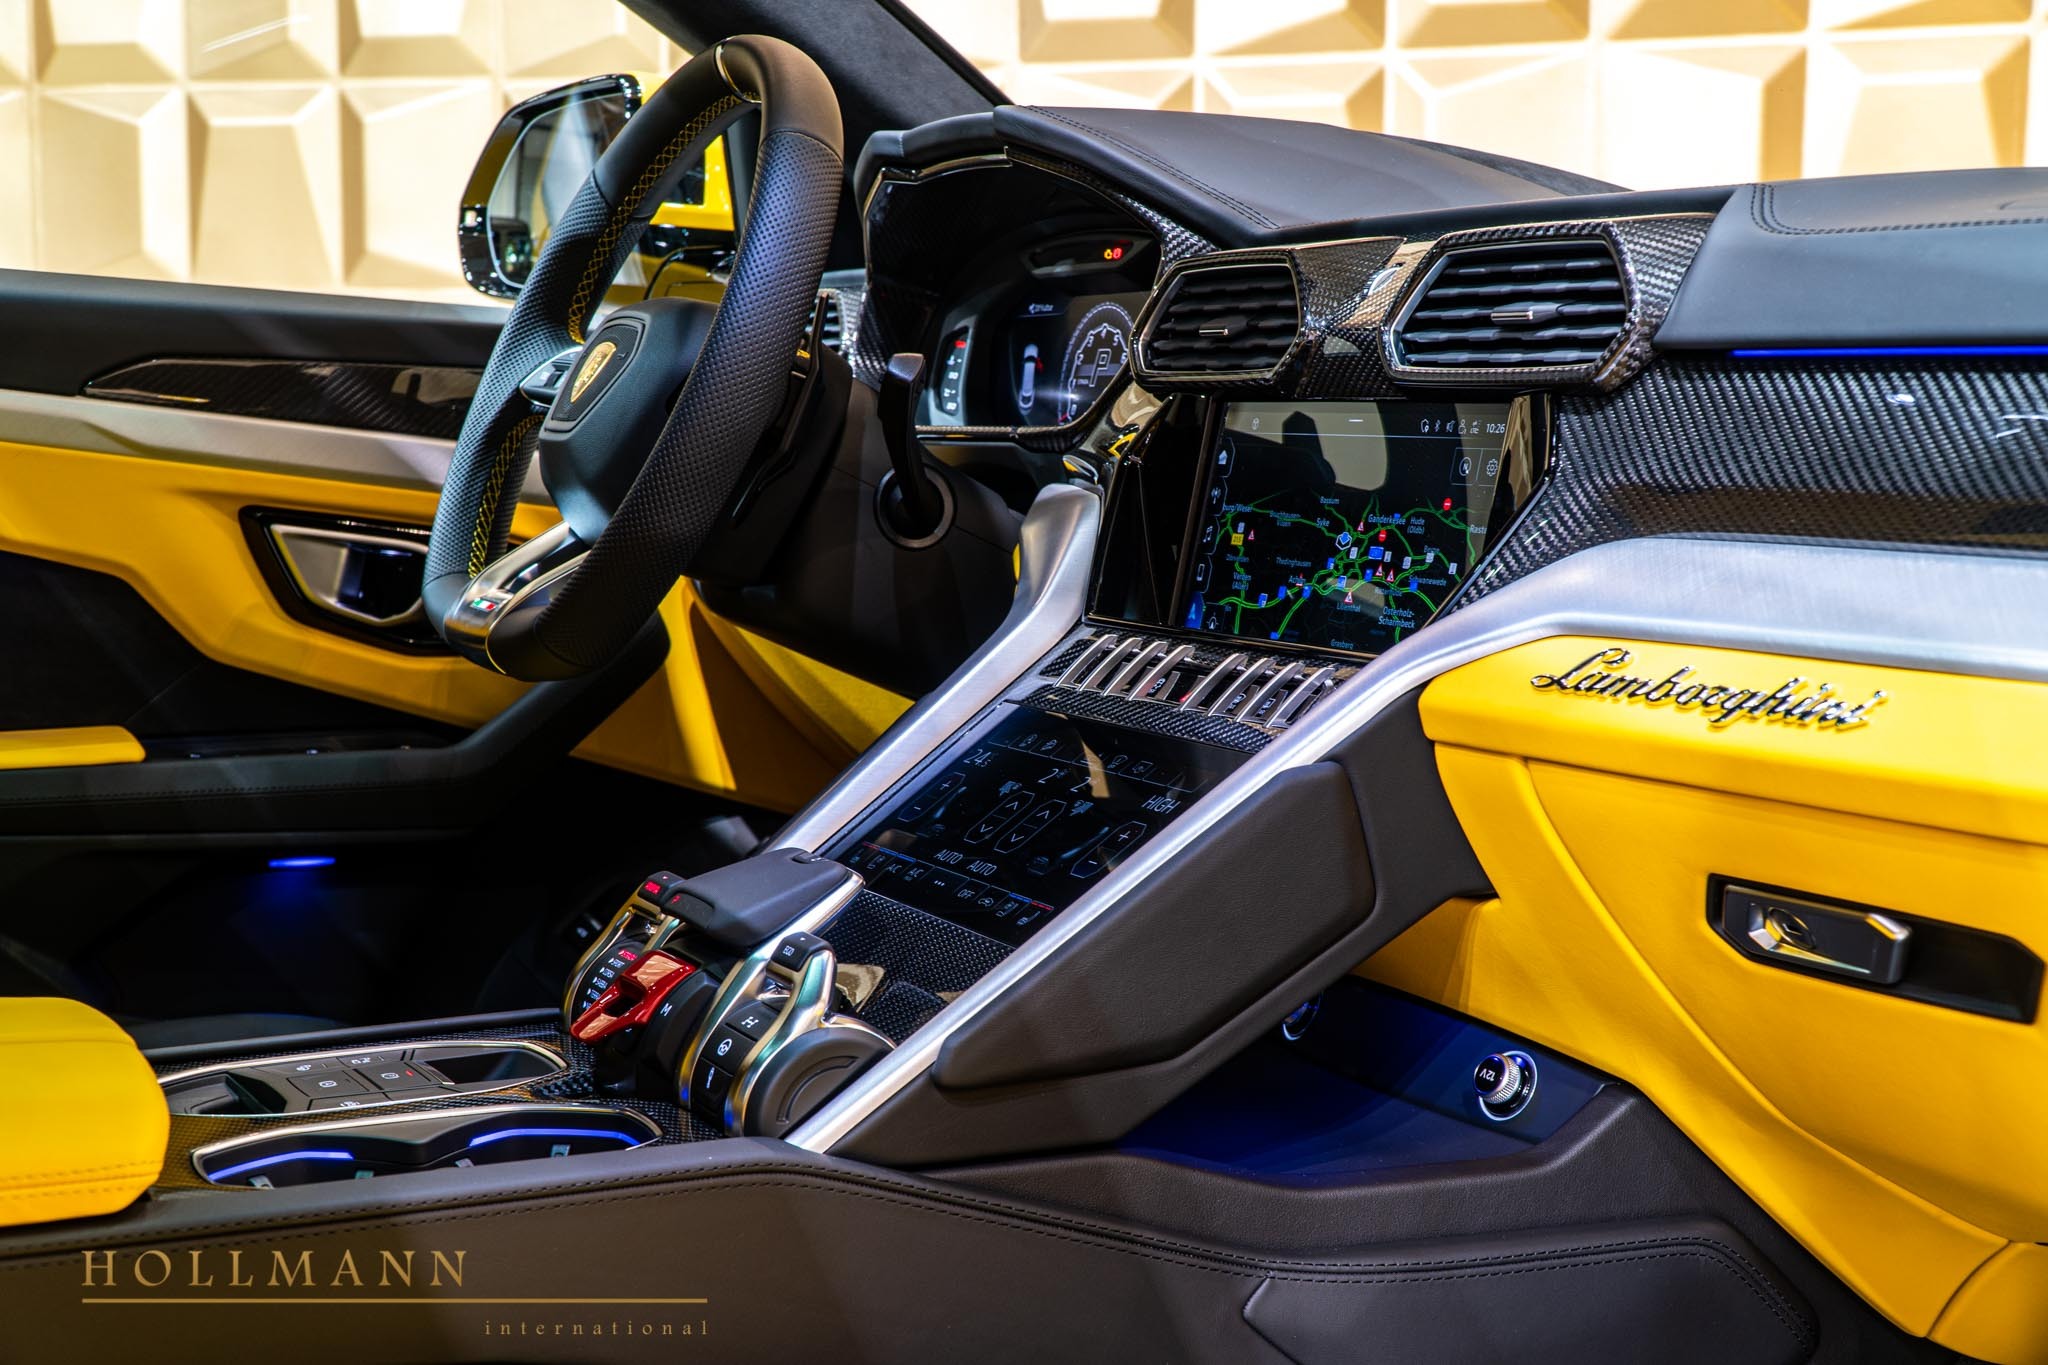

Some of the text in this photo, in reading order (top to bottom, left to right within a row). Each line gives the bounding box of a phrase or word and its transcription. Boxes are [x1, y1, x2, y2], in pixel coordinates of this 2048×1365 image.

[1486, 423, 1506, 434] 10:26
[1316, 517, 1330, 529] Syke
[1530, 647, 1889, 729] Lamborghini
[1141, 795, 1181, 814] HIGH
[934, 850, 998, 877] AUTO AUTO
[908, 867, 924, 878] AC
[956, 889, 975, 899] OFF
[660, 1002, 673, 1017] M
[1480, 1068, 1496, 1082] 12V
